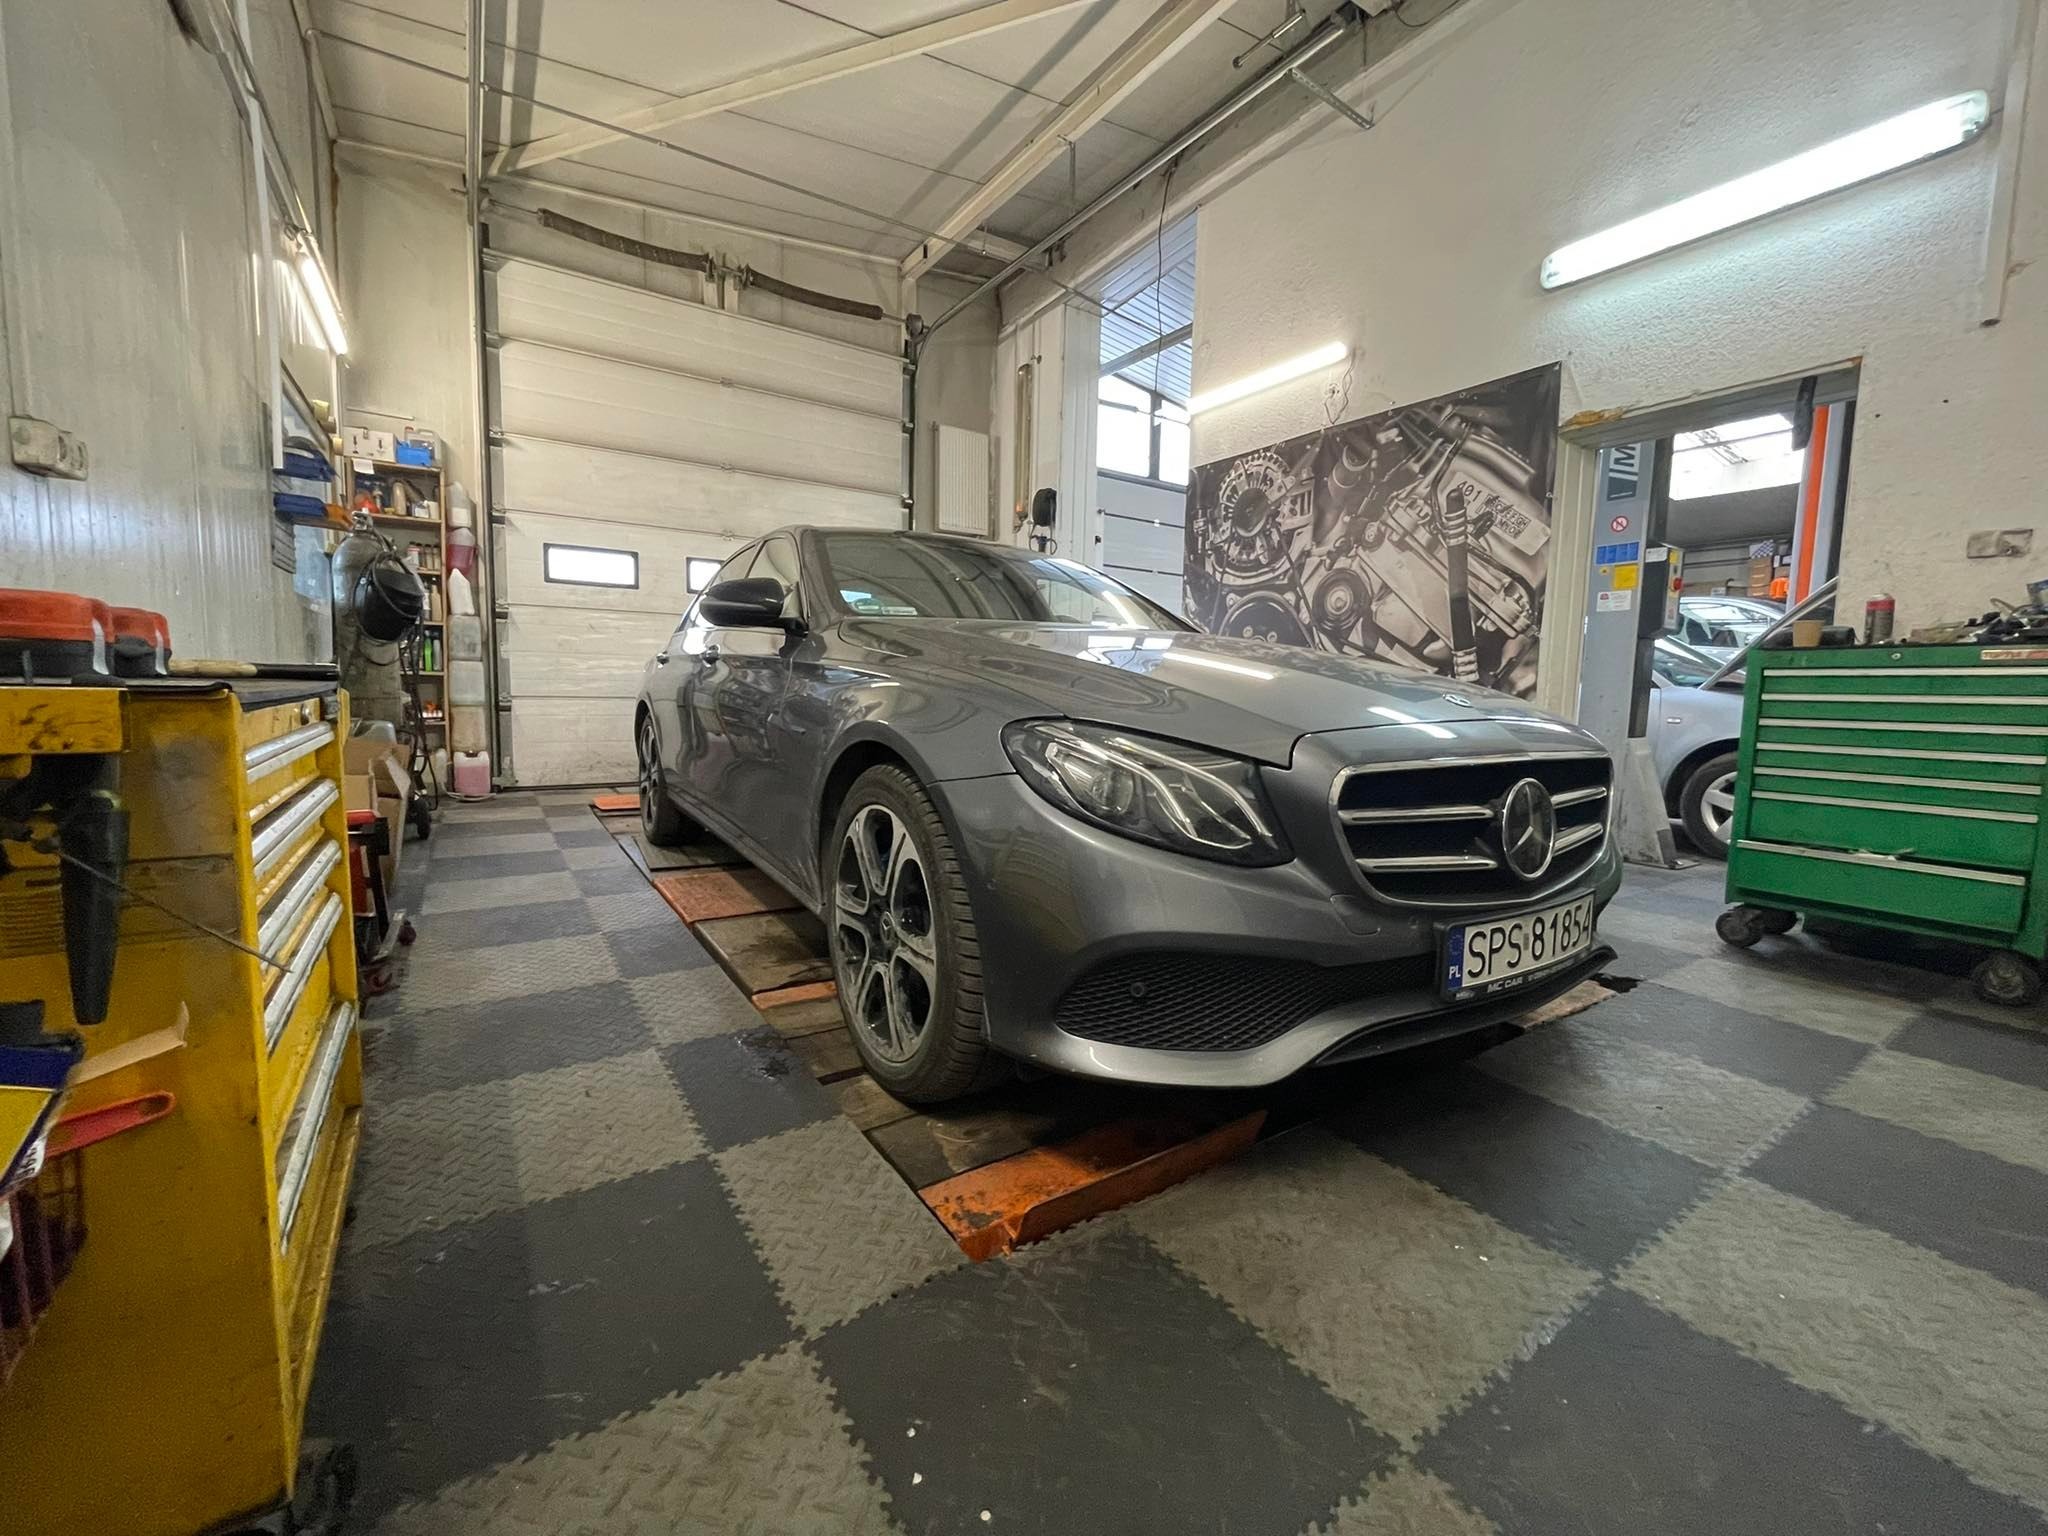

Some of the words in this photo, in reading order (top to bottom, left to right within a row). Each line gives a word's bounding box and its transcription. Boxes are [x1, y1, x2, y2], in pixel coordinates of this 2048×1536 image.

[1467, 923, 1523, 978] SPS
[1531, 901, 1593, 961] 81854
[1449, 966, 1461, 980] PL
